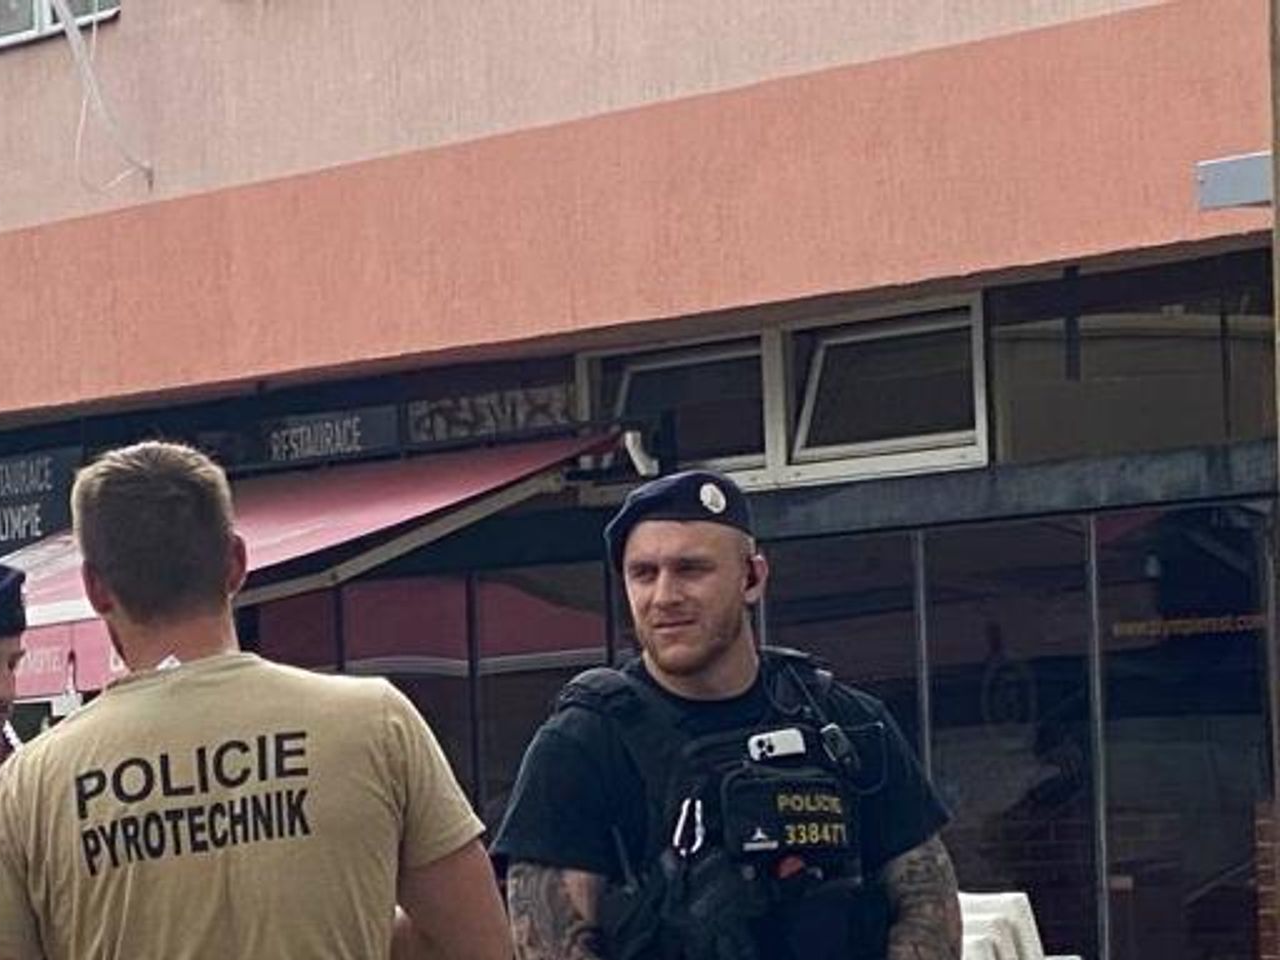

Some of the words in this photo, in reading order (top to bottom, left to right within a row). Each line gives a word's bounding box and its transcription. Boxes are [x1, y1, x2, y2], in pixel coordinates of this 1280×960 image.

[271, 417, 362, 462] RESTAURACE
[75, 731, 309, 819] POLICIE
[82, 788, 311, 876] PYROTECHNIK
